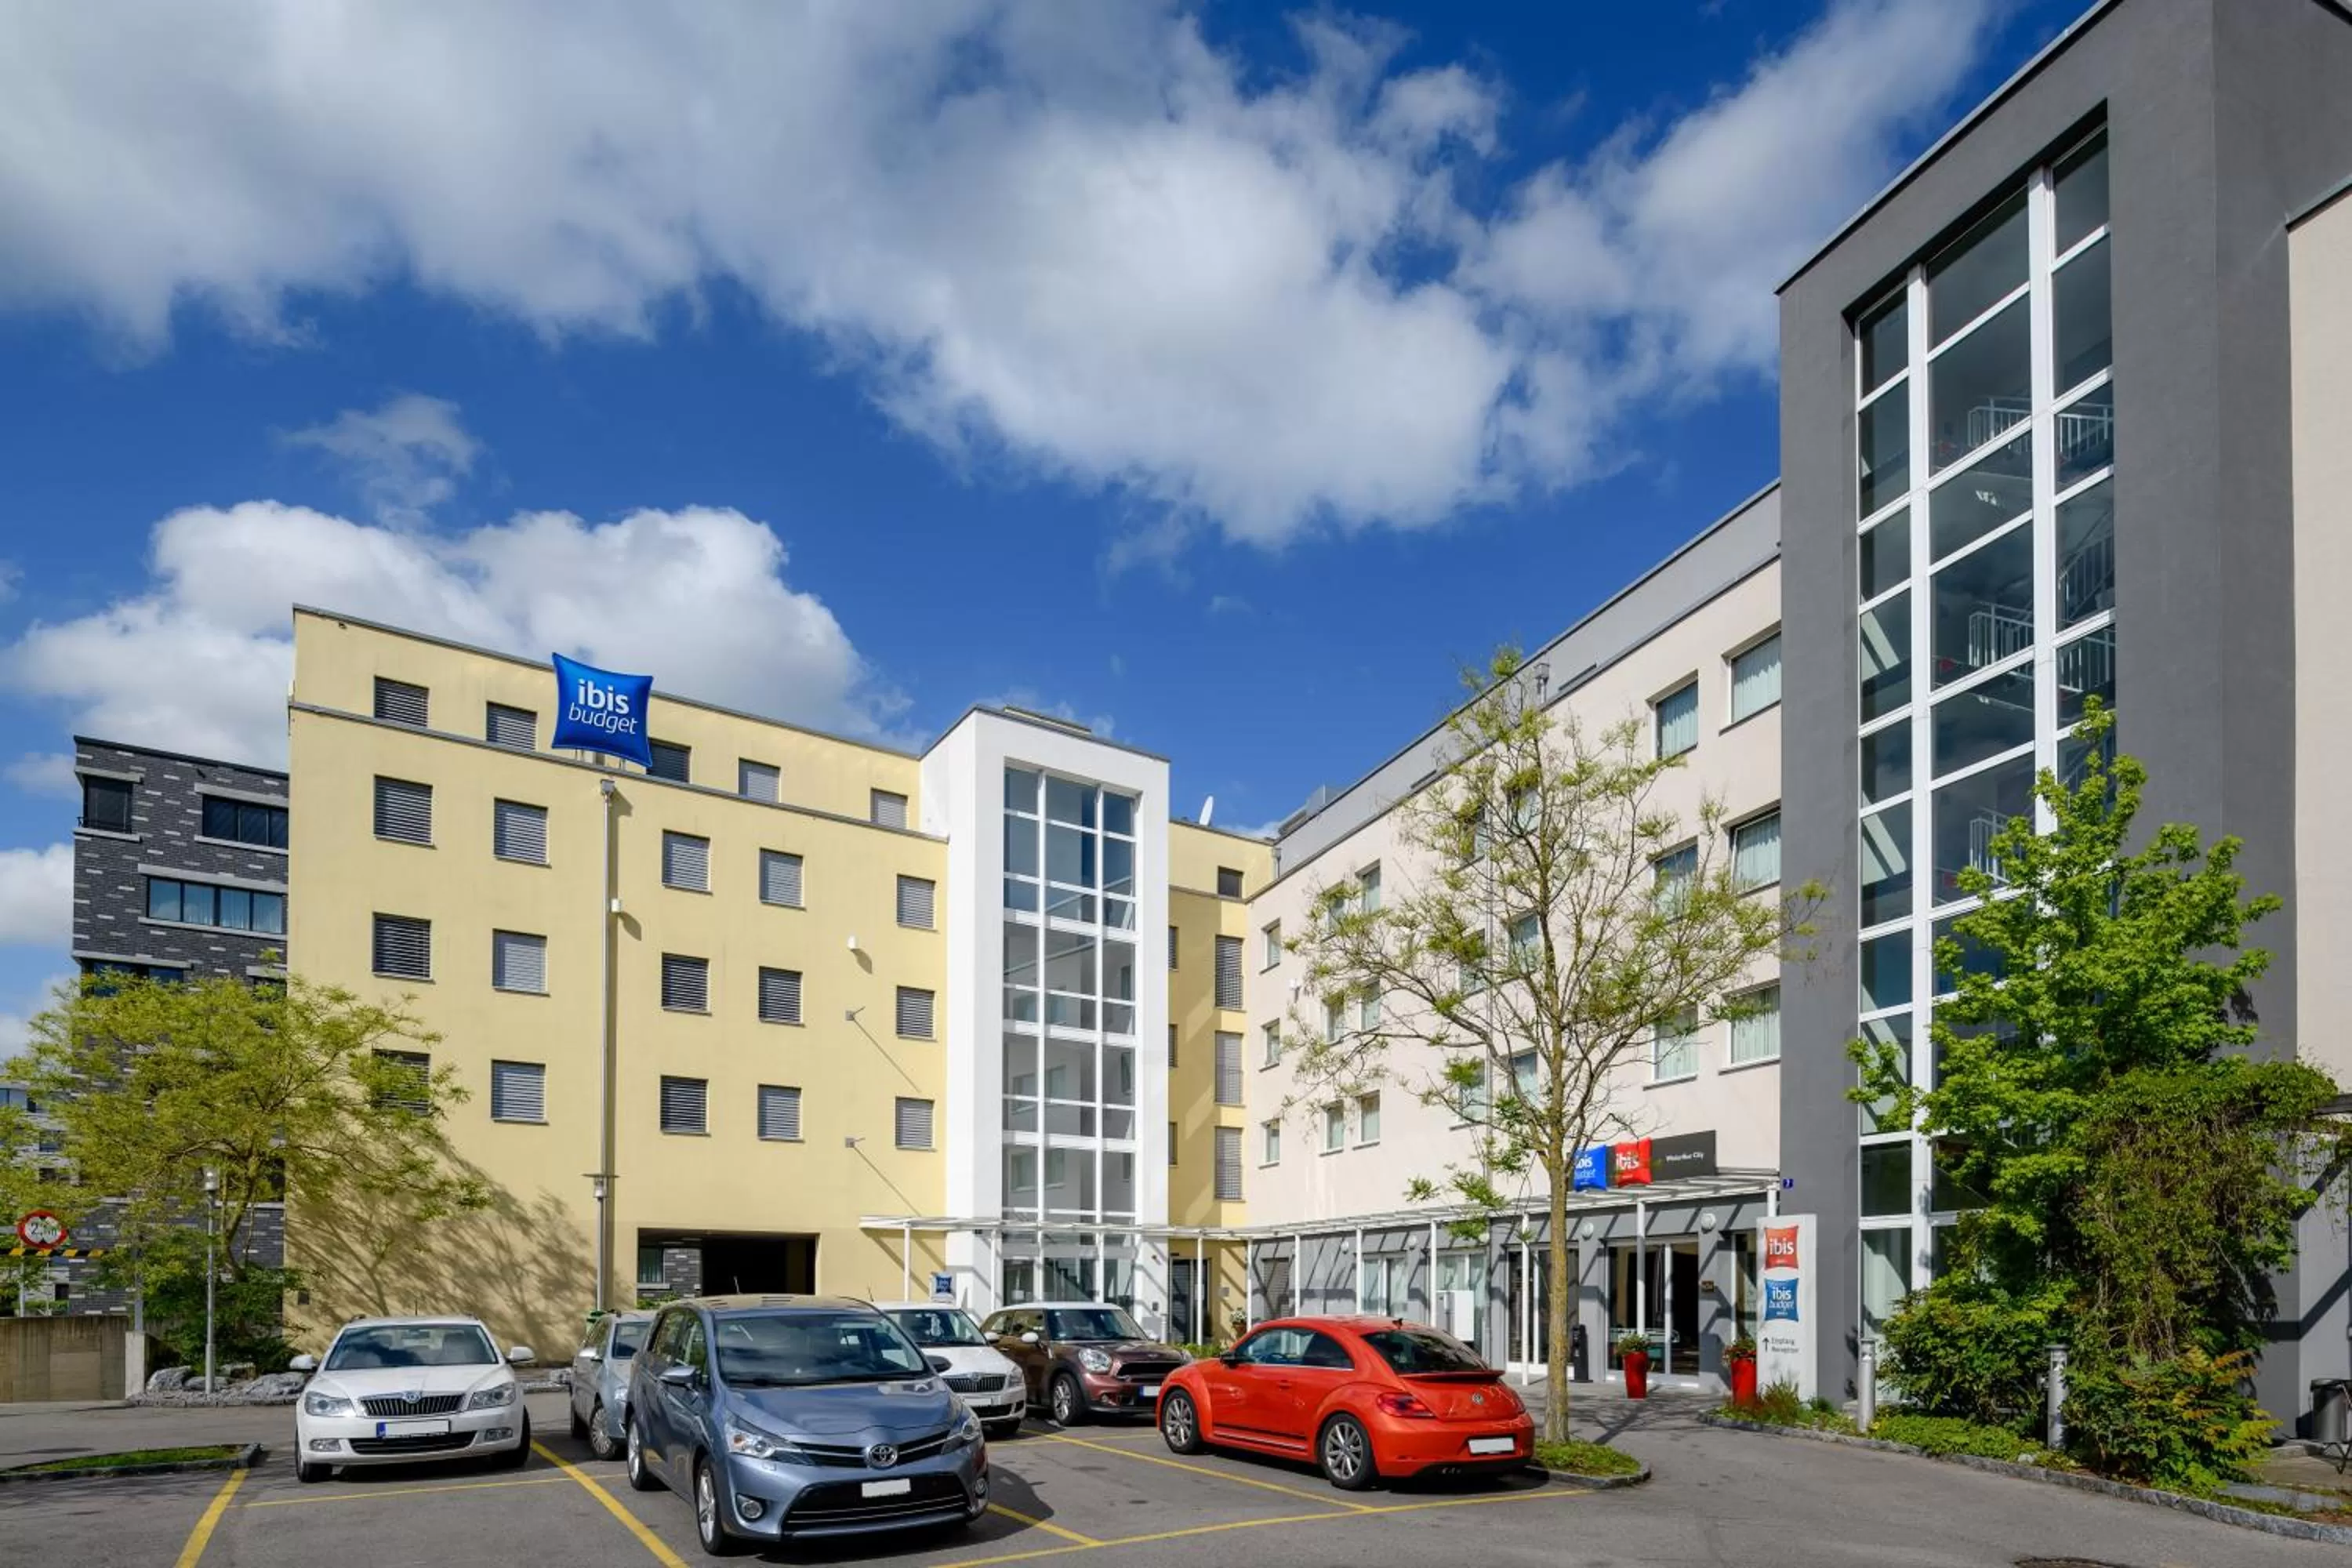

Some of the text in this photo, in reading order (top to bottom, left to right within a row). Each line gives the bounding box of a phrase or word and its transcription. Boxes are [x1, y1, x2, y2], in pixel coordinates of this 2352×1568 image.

[578, 678, 630, 714] ibis
[568, 702, 639, 735] budget
[1769, 1237, 1795, 1255] ibis
[1772, 1287, 1792, 1300] ibis
[1769, 1299, 1795, 1312] budget
